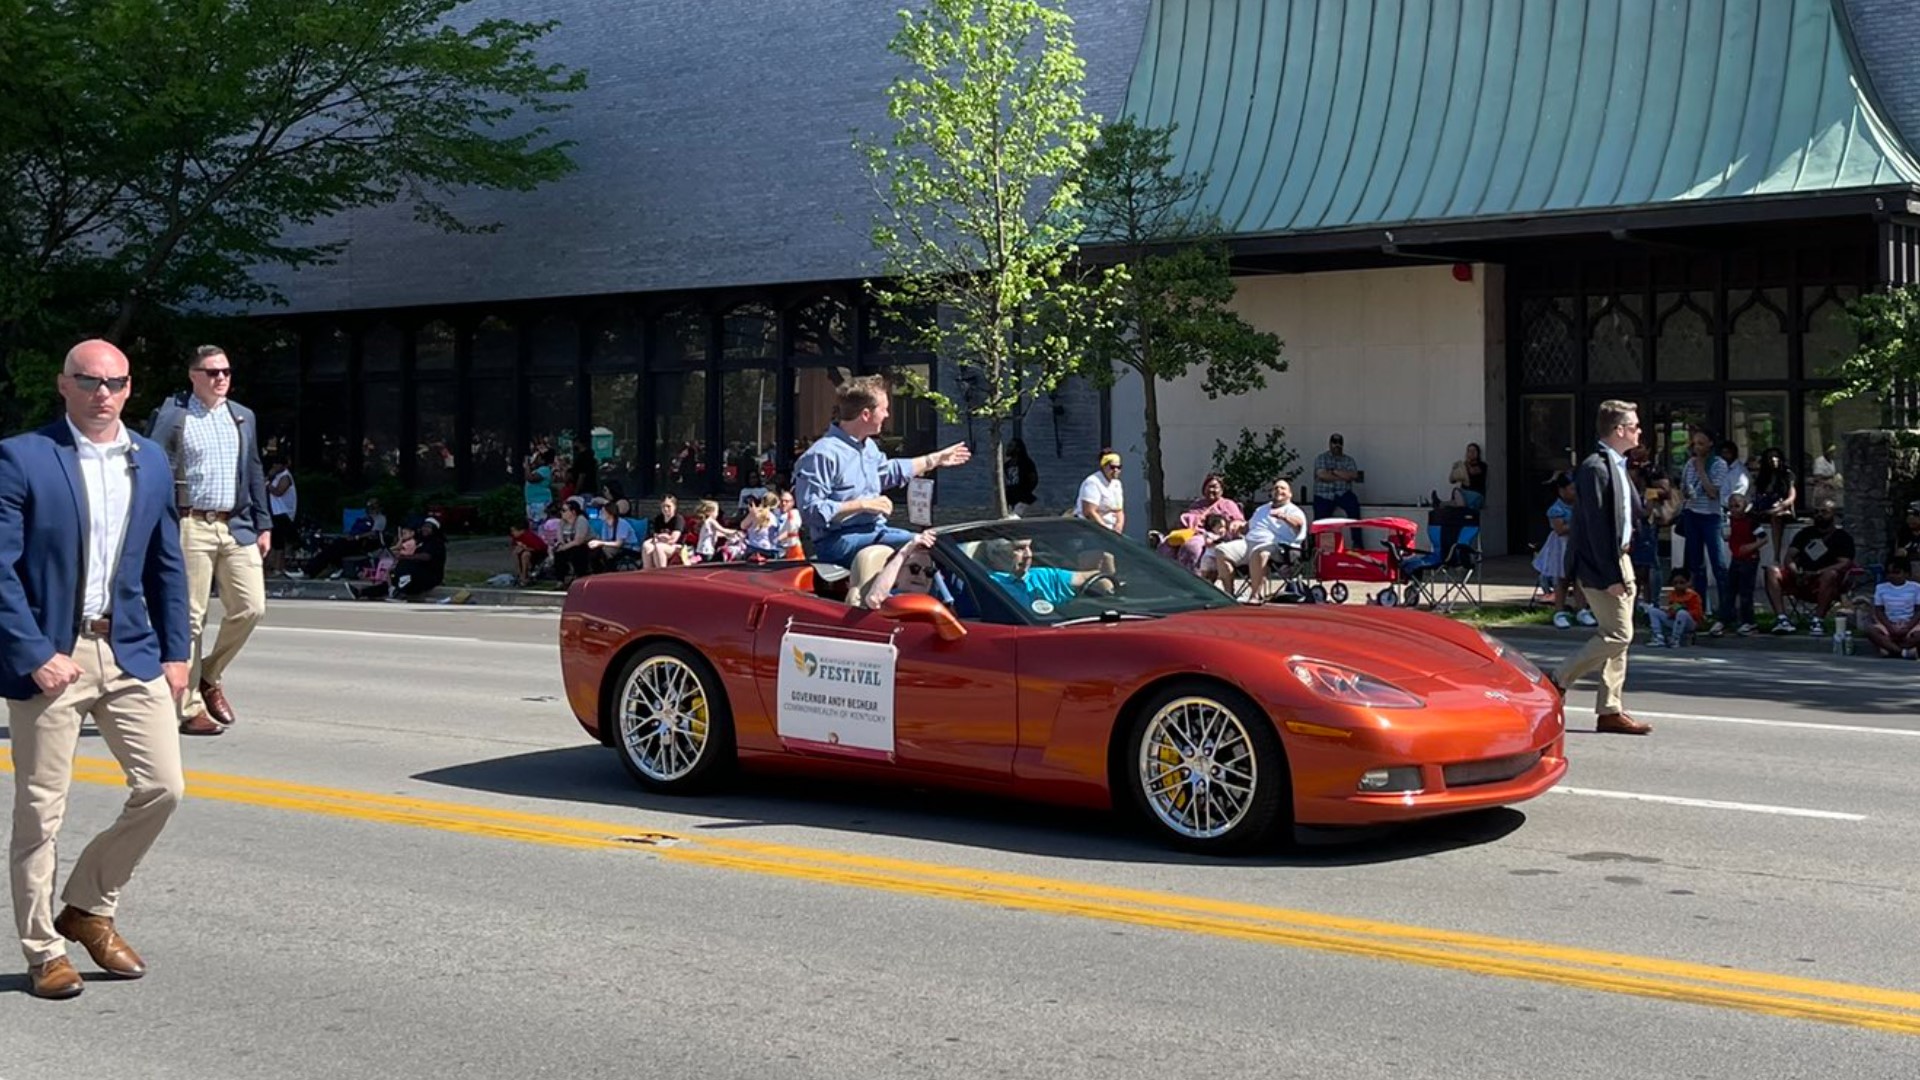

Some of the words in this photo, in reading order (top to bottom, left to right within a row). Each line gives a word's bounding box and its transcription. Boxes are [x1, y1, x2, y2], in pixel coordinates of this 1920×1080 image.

[819, 665, 882, 686] FESTIVAL
[791, 690, 827, 704] GOVERNOR
[828, 696, 845, 707] ANDY
[847, 698, 878, 711] BESHEAR
[784, 703, 838, 716] COMMONWEALTH
[840, 710, 848, 718] OF
[850, 711, 885, 723] KENTUCKY
